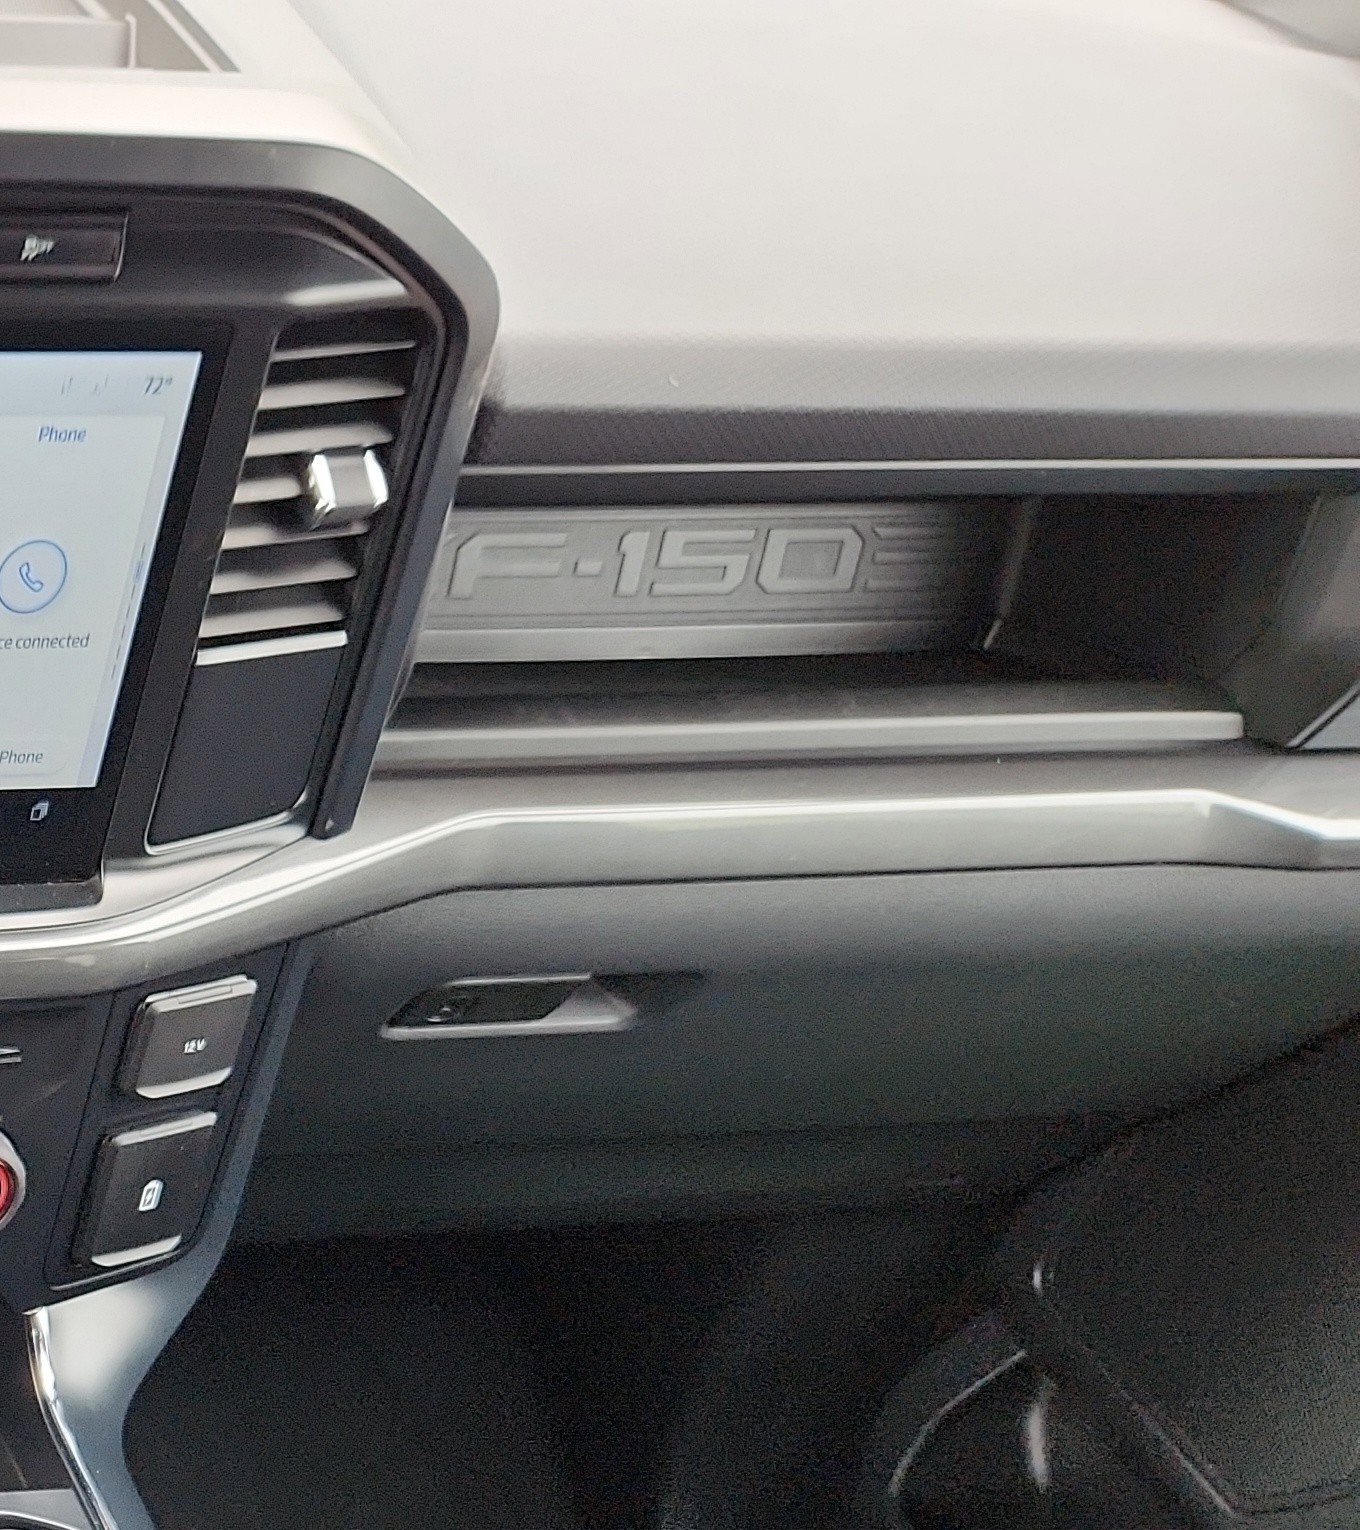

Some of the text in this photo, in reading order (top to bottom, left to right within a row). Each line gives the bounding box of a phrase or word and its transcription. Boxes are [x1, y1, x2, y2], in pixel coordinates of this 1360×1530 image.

[38, 425, 87, 444] Phone
[446, 526, 865, 599] F-150
[15, 633, 91, 650] connected
[0, 750, 43, 765] Phone
